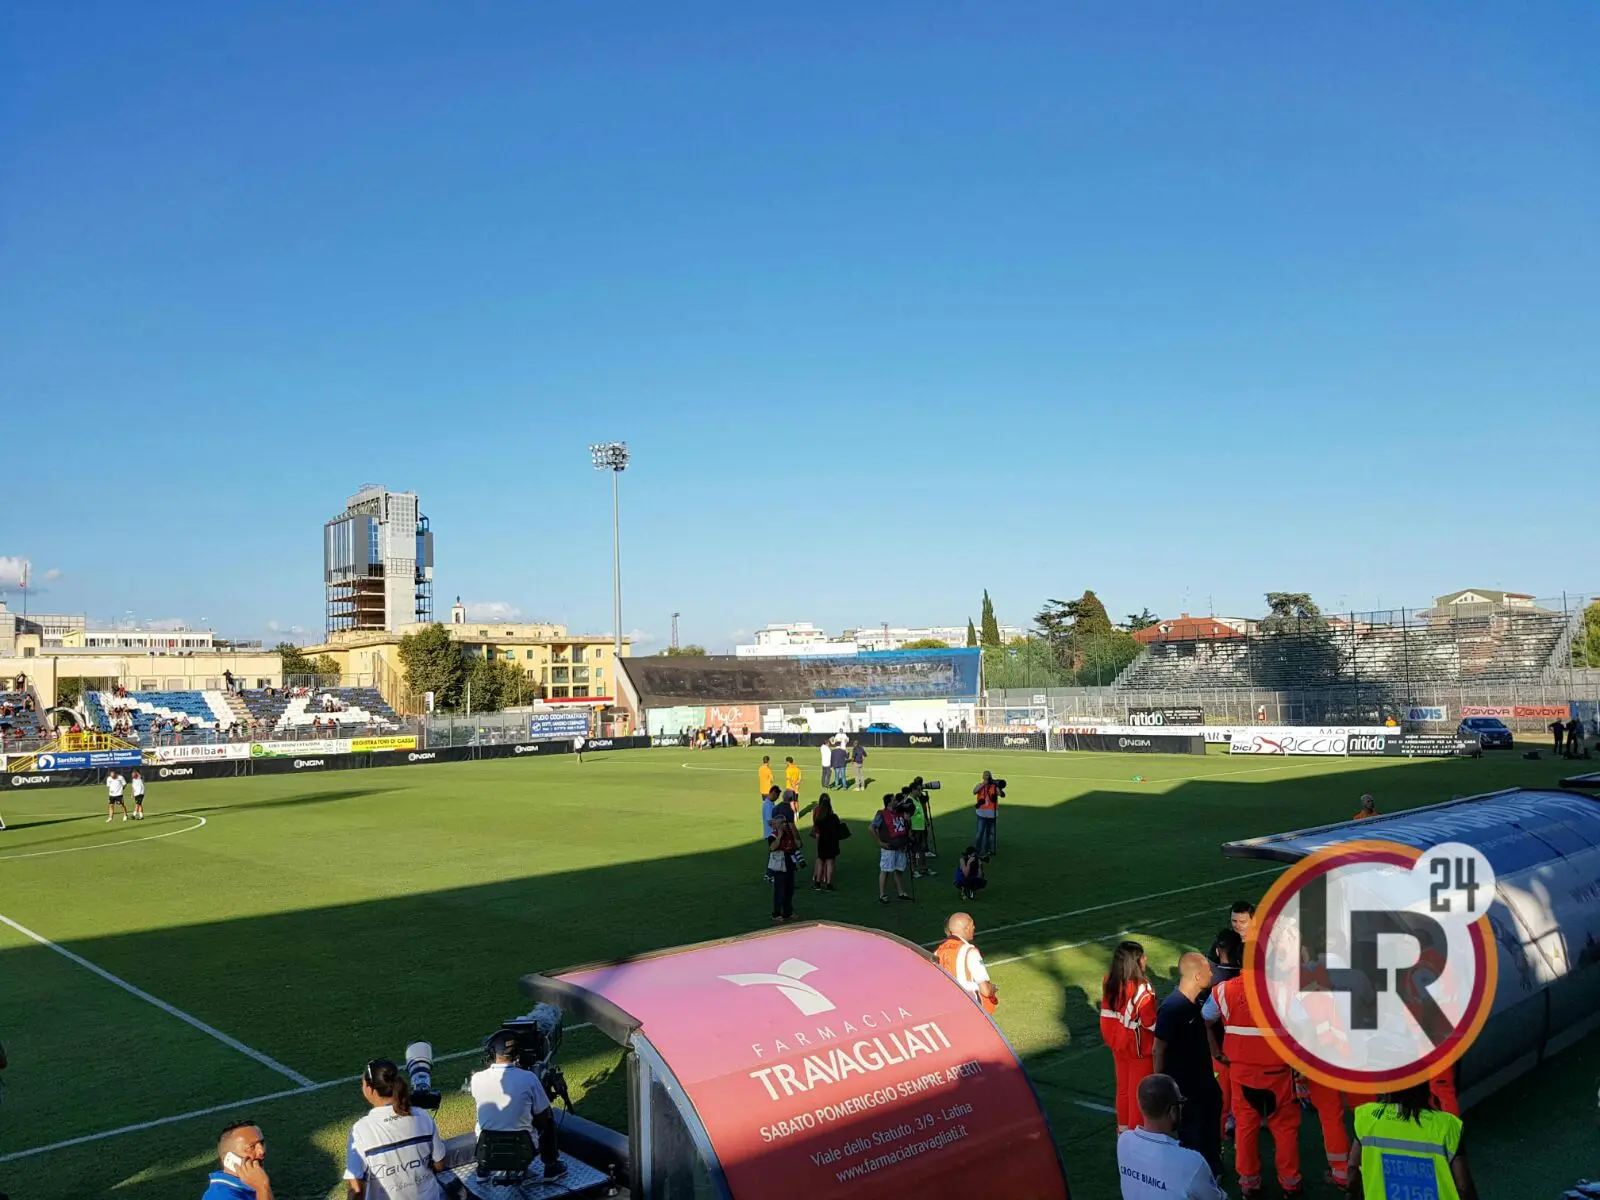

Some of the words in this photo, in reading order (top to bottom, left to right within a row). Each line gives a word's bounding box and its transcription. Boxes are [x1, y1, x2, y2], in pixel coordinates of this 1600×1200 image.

[1129, 711, 1163, 726] nitido
[1409, 708, 1442, 719] AVIS
[1471, 707, 1510, 716] GIVOVA
[1525, 707, 1565, 716] GIVOVA
[1126, 739, 1151, 747] NGM
[1232, 743, 1252, 752] bici
[1280, 737, 1346, 752] RICCIO
[1349, 735, 1385, 750] nitido
[302, 759, 324, 768] NGM
[416, 752, 436, 760] NGM
[168, 767, 193, 776] NGM
[22, 775, 50, 784] NGM
[751, 1006, 912, 1058] FARMACIA
[749, 1021, 952, 1101] TRAVAGLIATI
[760, 1112, 815, 1143] SABATO
[816, 1086, 898, 1124] POMERIGGIO
[897, 1073, 945, 1097] SEMPRE
[946, 1059, 983, 1084] APERTI
[810, 1145, 842, 1168] Viale
[844, 1137, 872, 1157] dello
[872, 1121, 915, 1146] Statuto,
[915, 1113, 935, 1132] 3/9
[943, 1101, 973, 1121] Latina
[835, 1124, 969, 1183] www.farmaciatravagliati.it
[1384, 1158, 1434, 1179] STEWARD
[1120, 1166, 1140, 1181] CROCE
[1141, 1173, 1167, 1191] BIANCA
